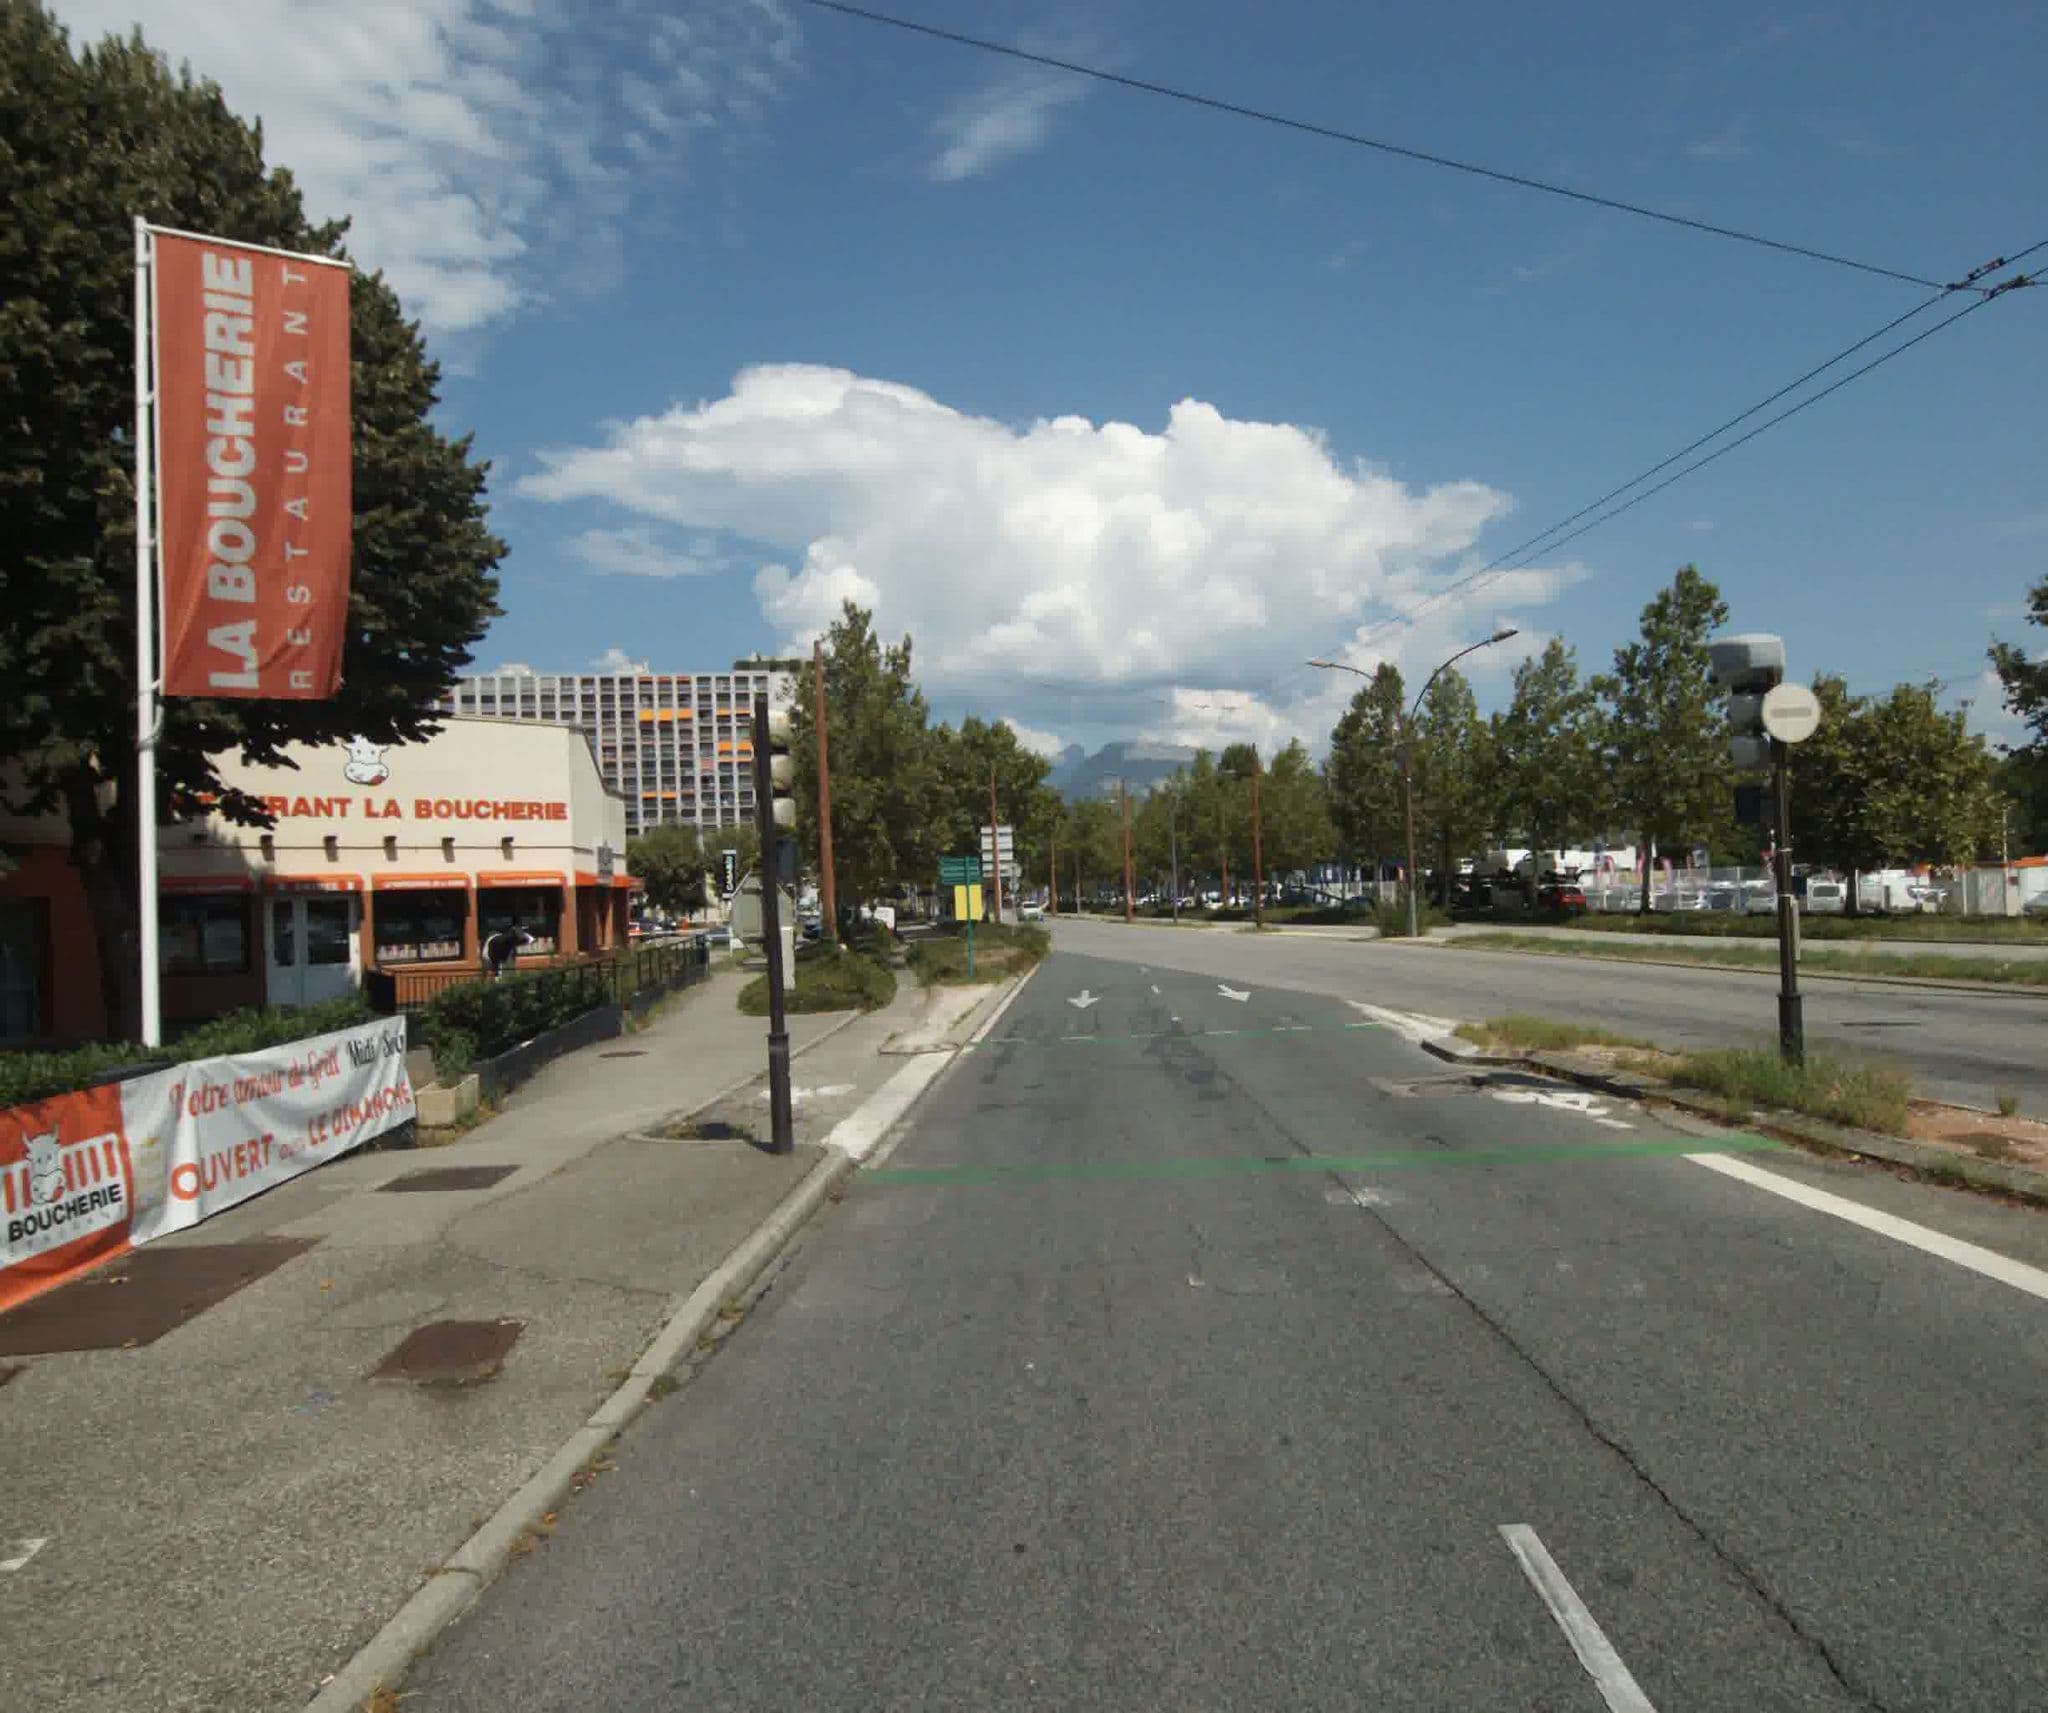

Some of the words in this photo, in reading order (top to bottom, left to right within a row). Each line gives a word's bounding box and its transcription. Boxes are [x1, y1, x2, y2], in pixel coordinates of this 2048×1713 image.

[201, 251, 257, 604] BOUCHERIE
[281, 266, 314, 691] RESTAURANT
[208, 617, 261, 691] LA
[364, 796, 402, 819] LA
[414, 797, 568, 821] BOUCHERIE
[170, 1132, 275, 1201] OUVERT
[307, 1118, 329, 1146] LE
[331, 1080, 412, 1137] DIMANCHE
[8, 1183, 123, 1243] BOUCHERIE
